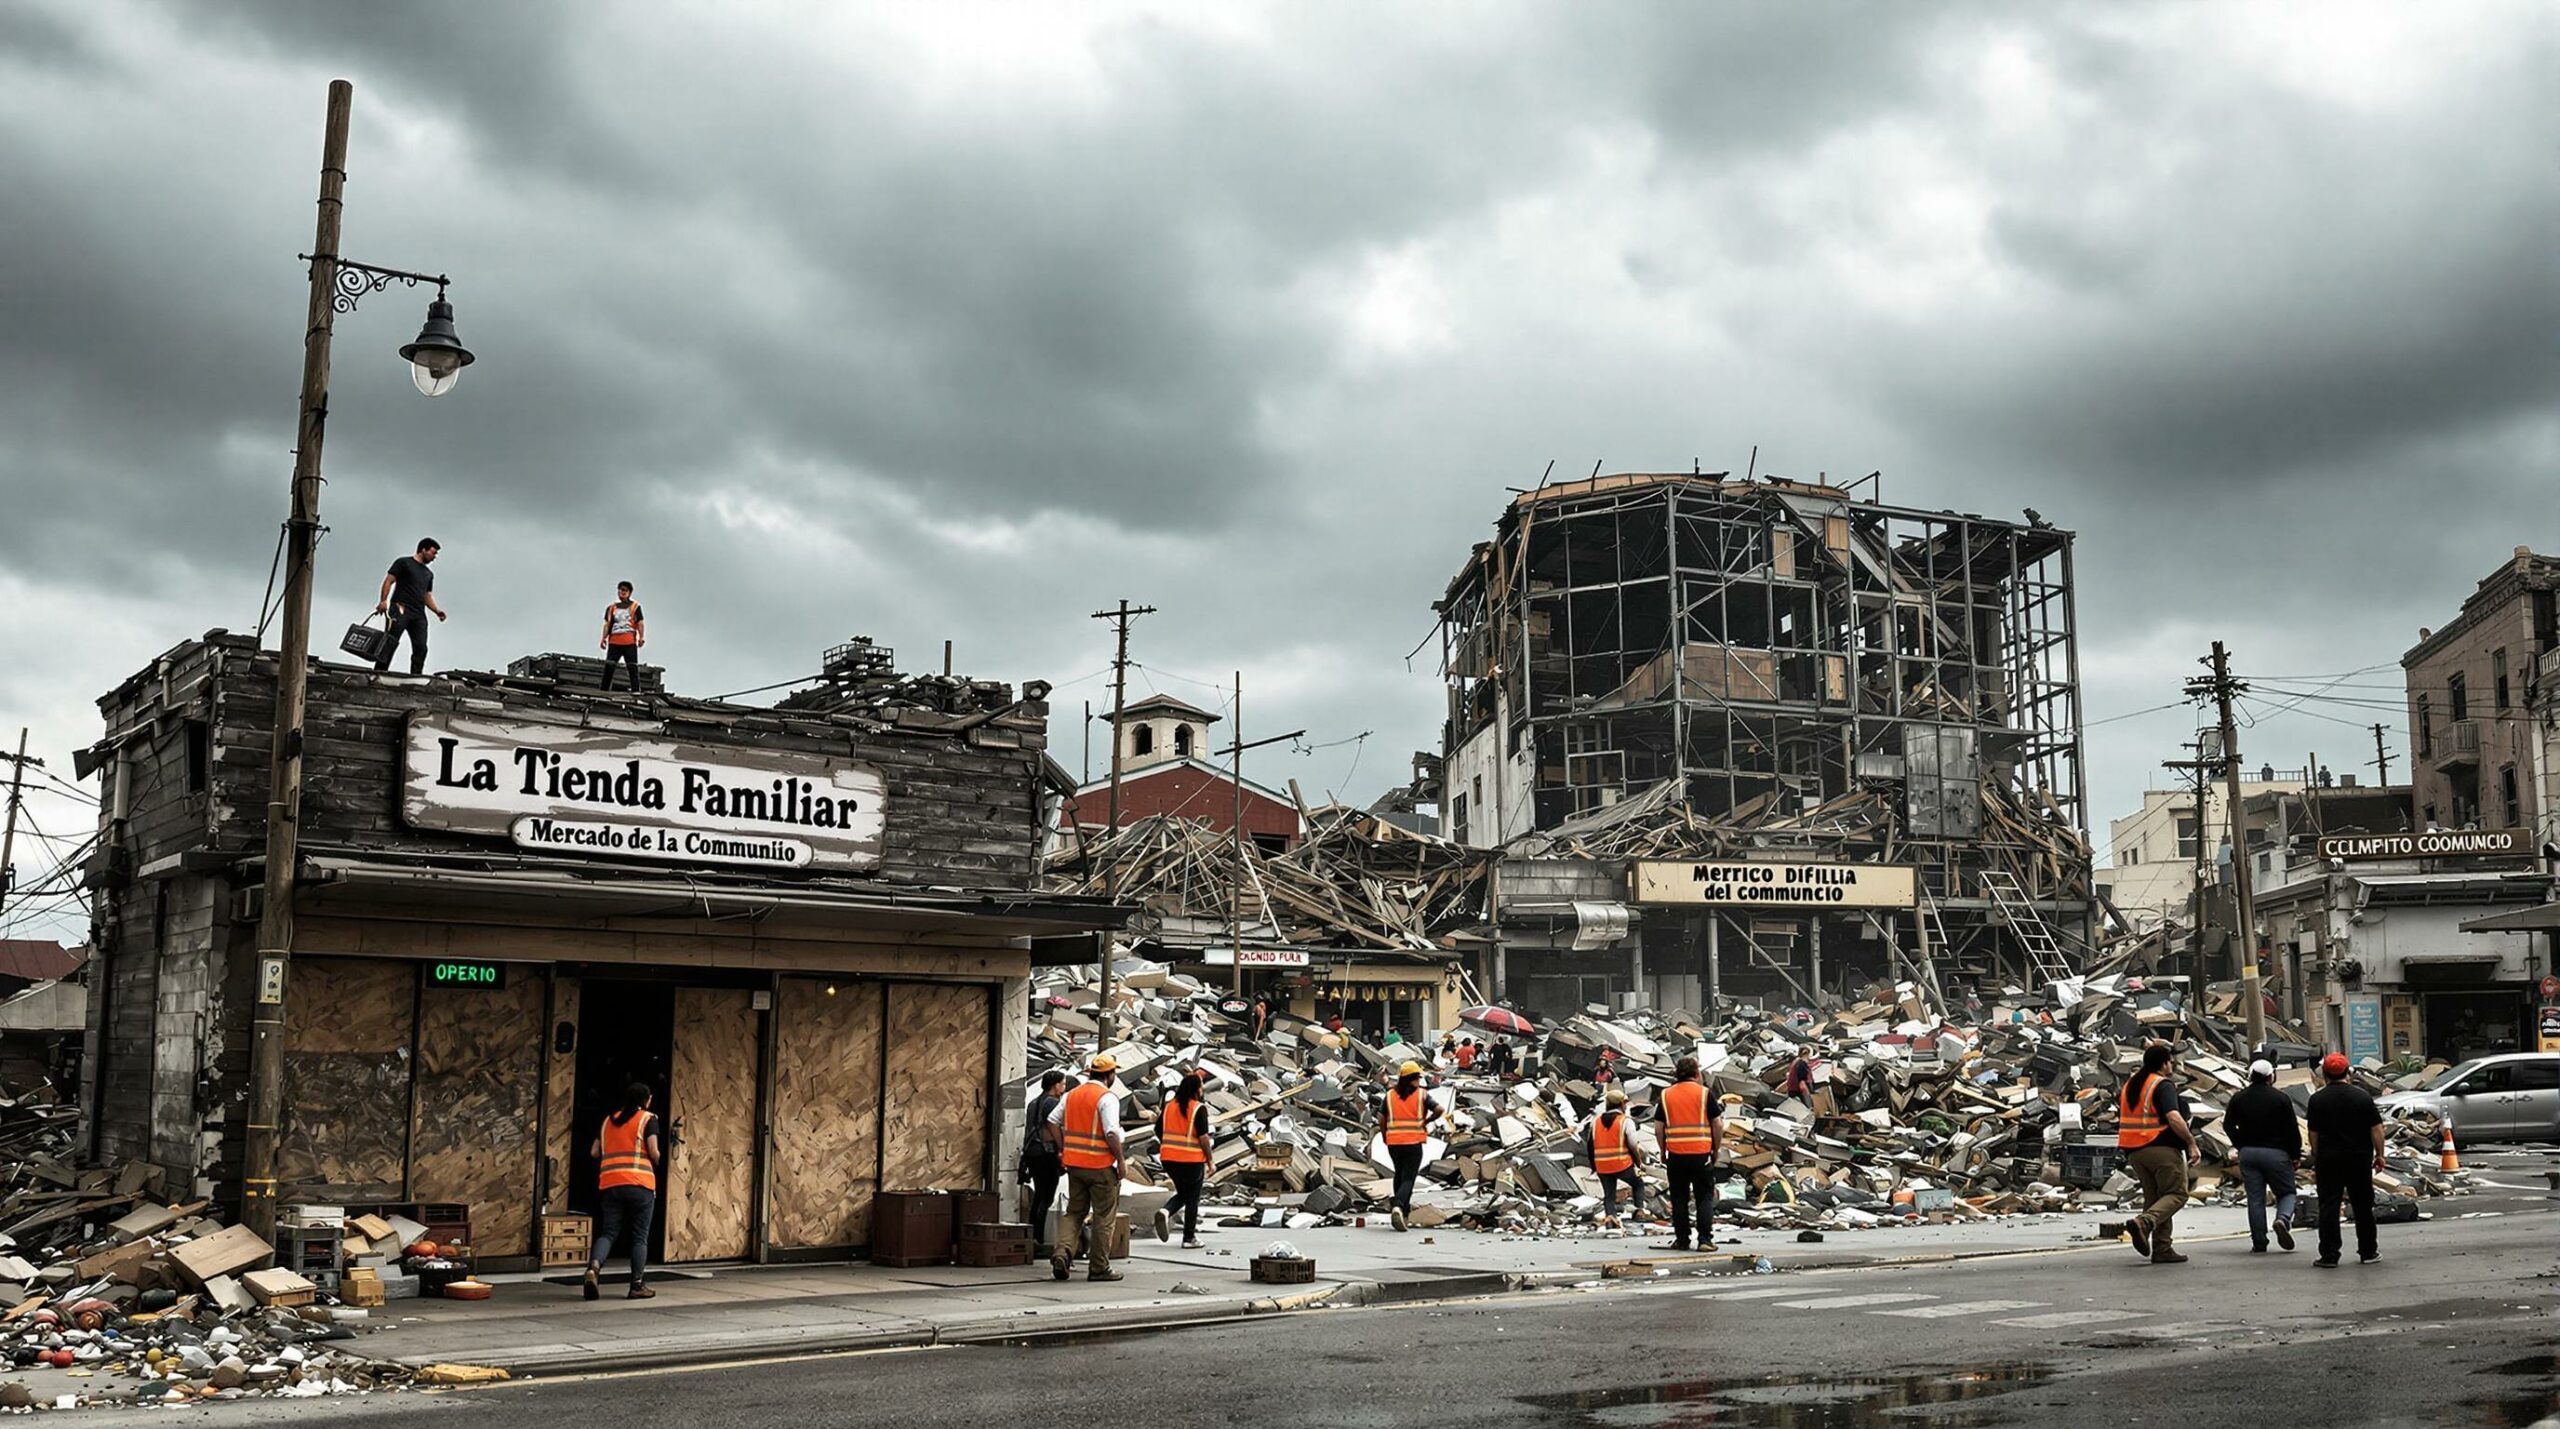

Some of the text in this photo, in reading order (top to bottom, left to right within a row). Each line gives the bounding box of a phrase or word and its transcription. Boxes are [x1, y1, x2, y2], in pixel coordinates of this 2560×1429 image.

[436, 737, 858, 829] La Tienda Familiar
[530, 818, 623, 848] Mercado
[628, 827, 652, 850] de
[657, 829, 678, 852] la
[2417, 833, 2512, 851] COOMUNCIO
[1704, 883, 1731, 901] del
[436, 964, 496, 982] OPERIO
